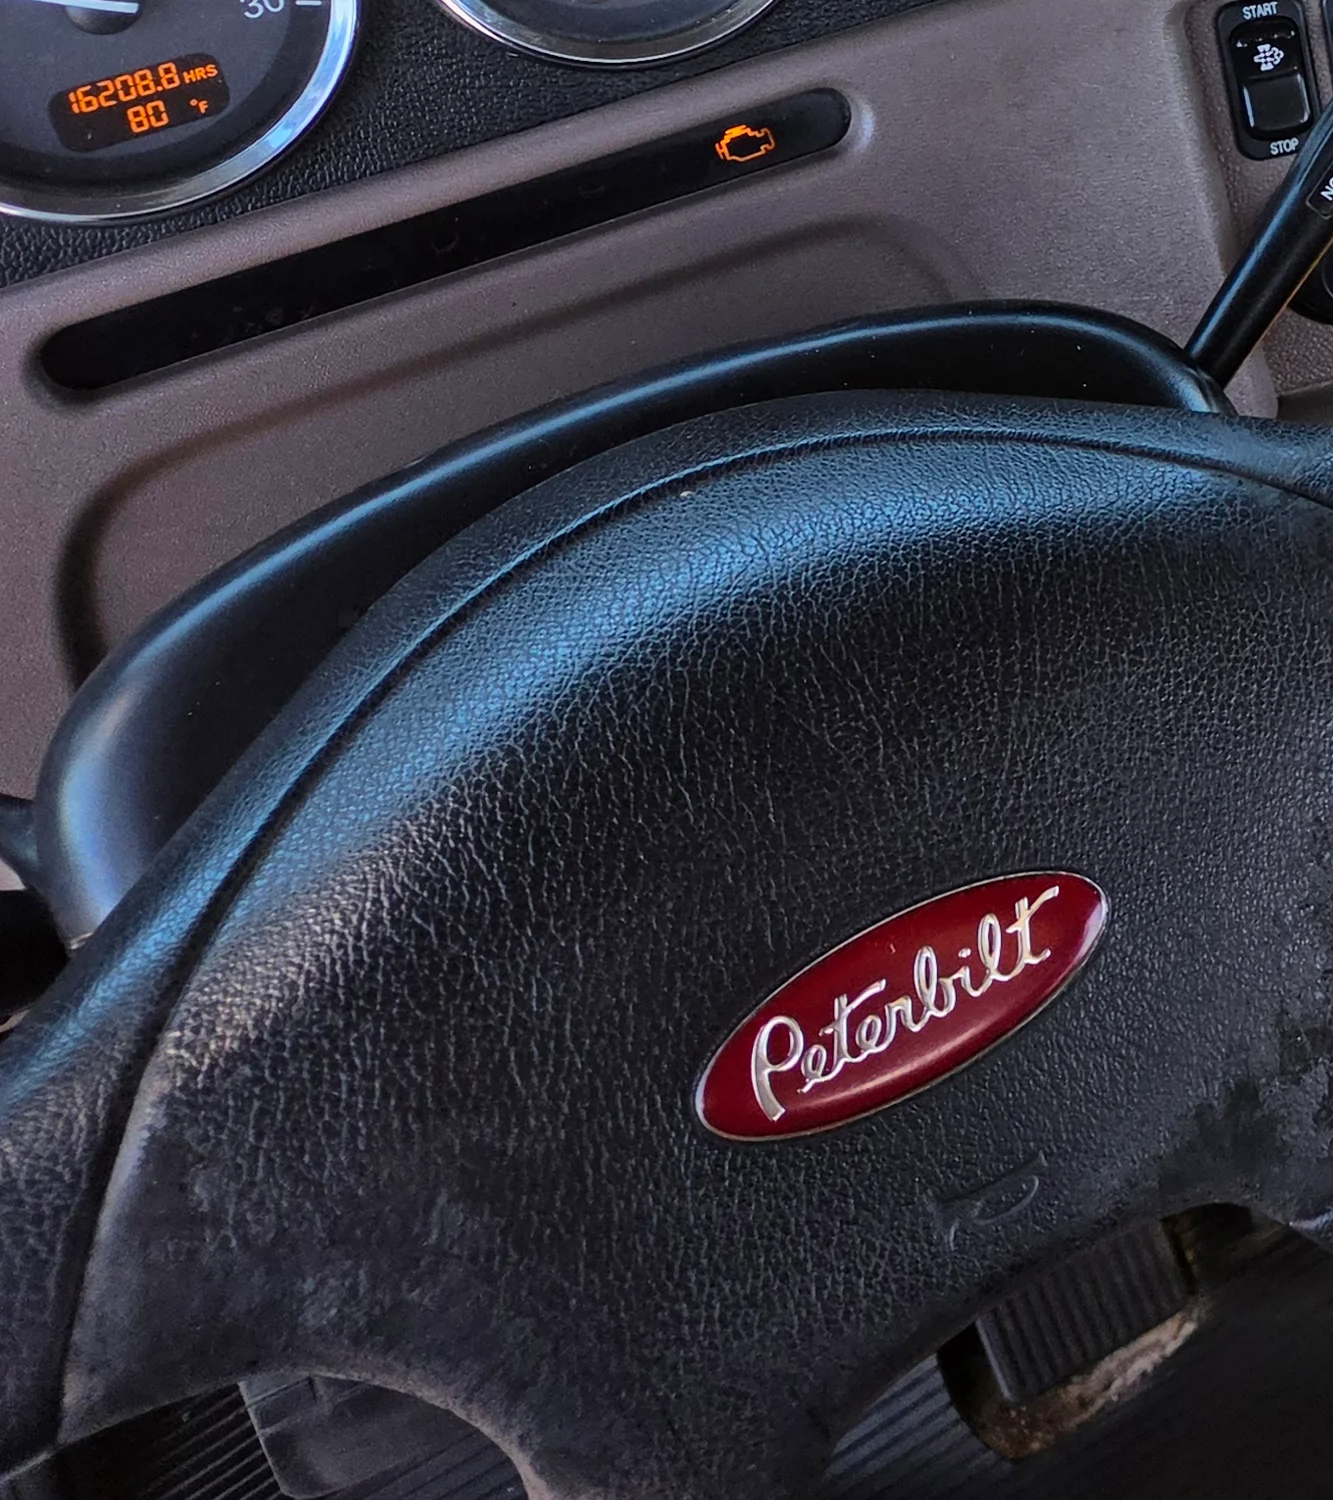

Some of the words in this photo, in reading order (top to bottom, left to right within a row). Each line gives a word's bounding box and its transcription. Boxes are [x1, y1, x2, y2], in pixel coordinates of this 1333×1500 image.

[1242, 1, 1278, 20] START
[68, 61, 181, 114] 16208.8
[182, 63, 219, 85] HRS
[126, 99, 169, 134] 80
[1270, 138, 1299, 155] STOP
[751, 886, 1059, 1122] Peterbilt
